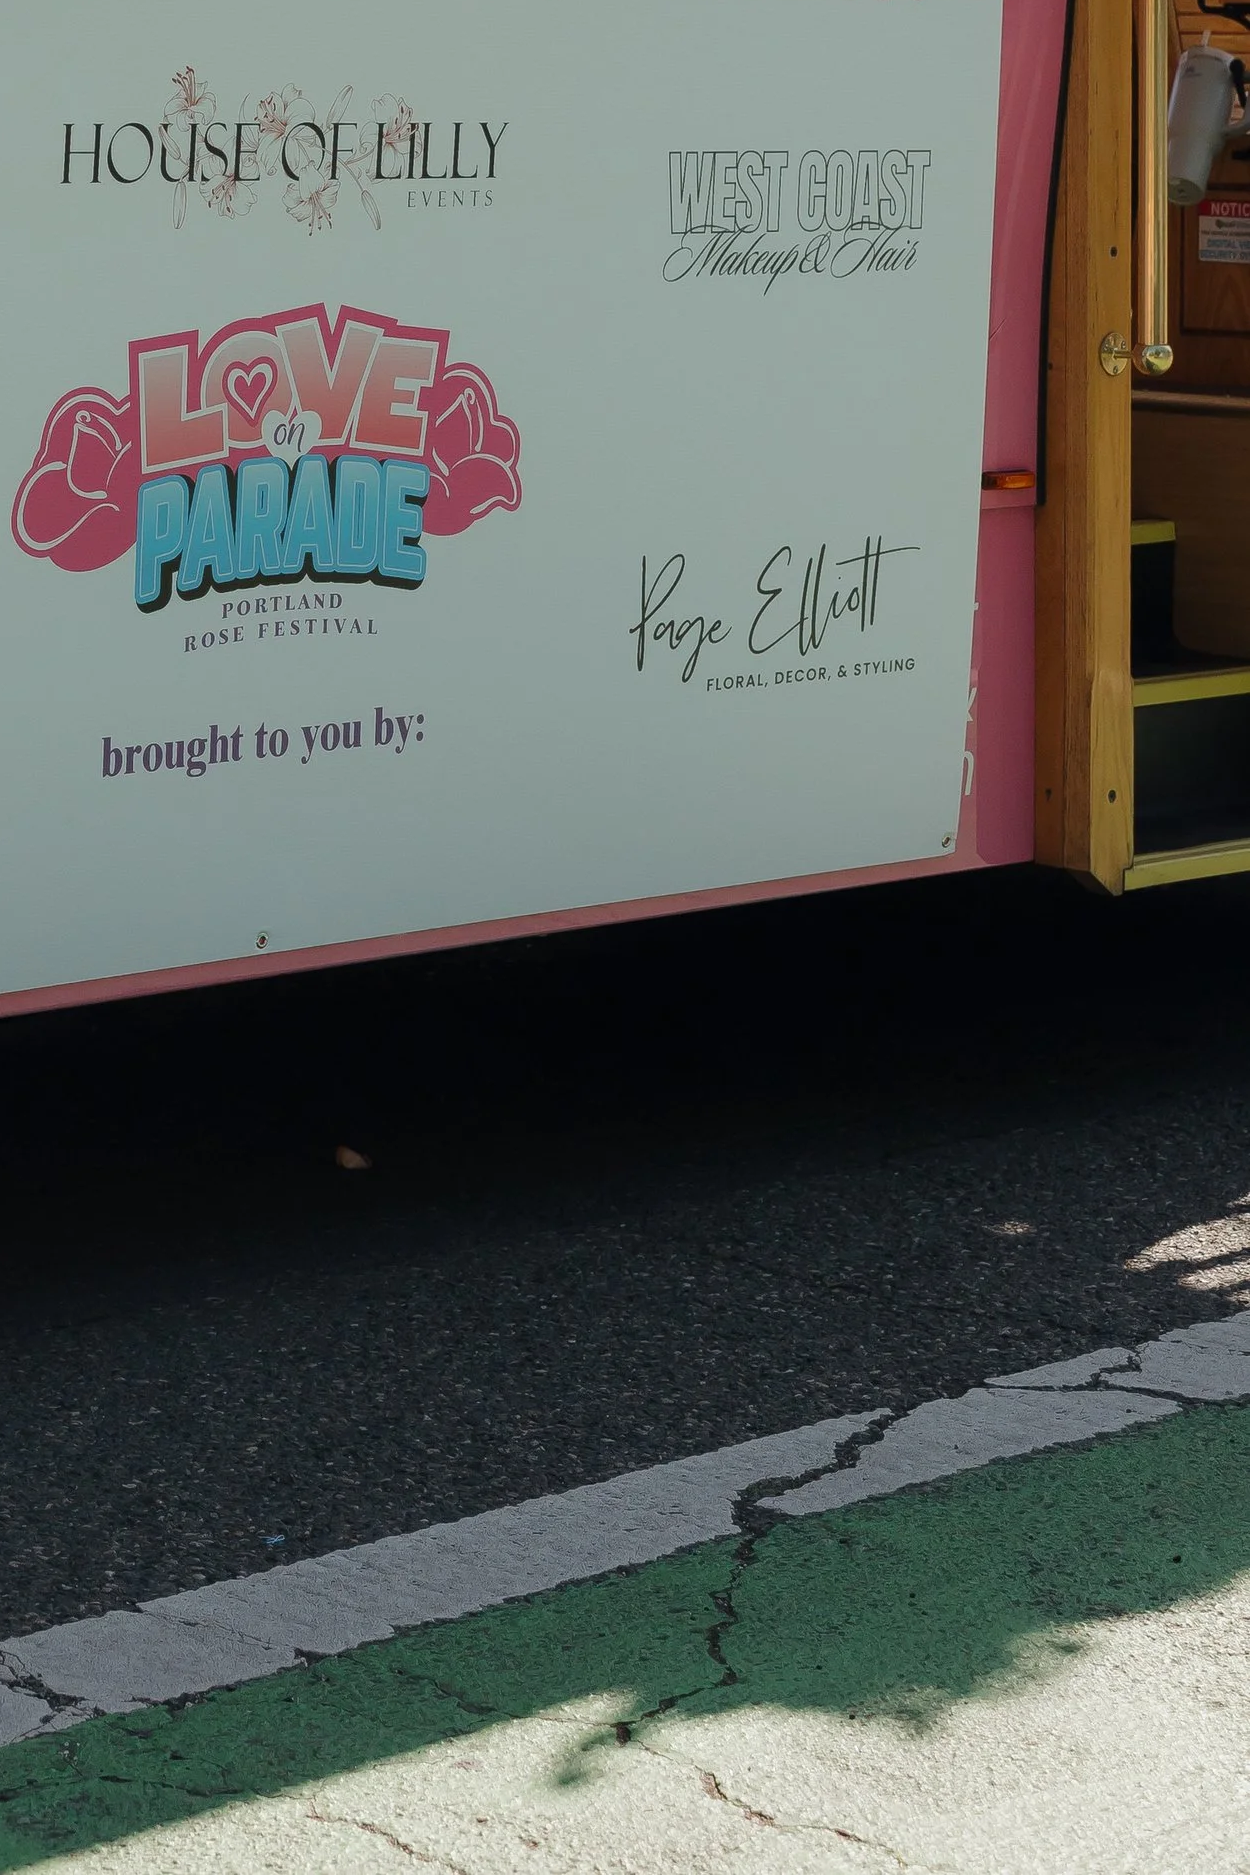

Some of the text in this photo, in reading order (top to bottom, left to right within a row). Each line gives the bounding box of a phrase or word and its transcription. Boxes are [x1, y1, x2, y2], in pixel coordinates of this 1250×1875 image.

[60, 121, 510, 185] HOUSE OF LILLY
[406, 189, 494, 209] EVENTS
[668, 149, 932, 235] WEST COAST
[662, 221, 920, 297] Makeup & Hair
[138, 315, 440, 475] LOVE
[272, 422, 306, 454] on
[134, 454, 432, 611] PARADE
[183, 618, 379, 653] ROSE FESTIVAL
[221, 592, 344, 620] PORTLAND
[629, 535, 921, 684] Page Elliott
[706, 657, 916, 692] FLORAL, DECOR, & STYLING
[102, 706, 426, 779] brought to you by:
